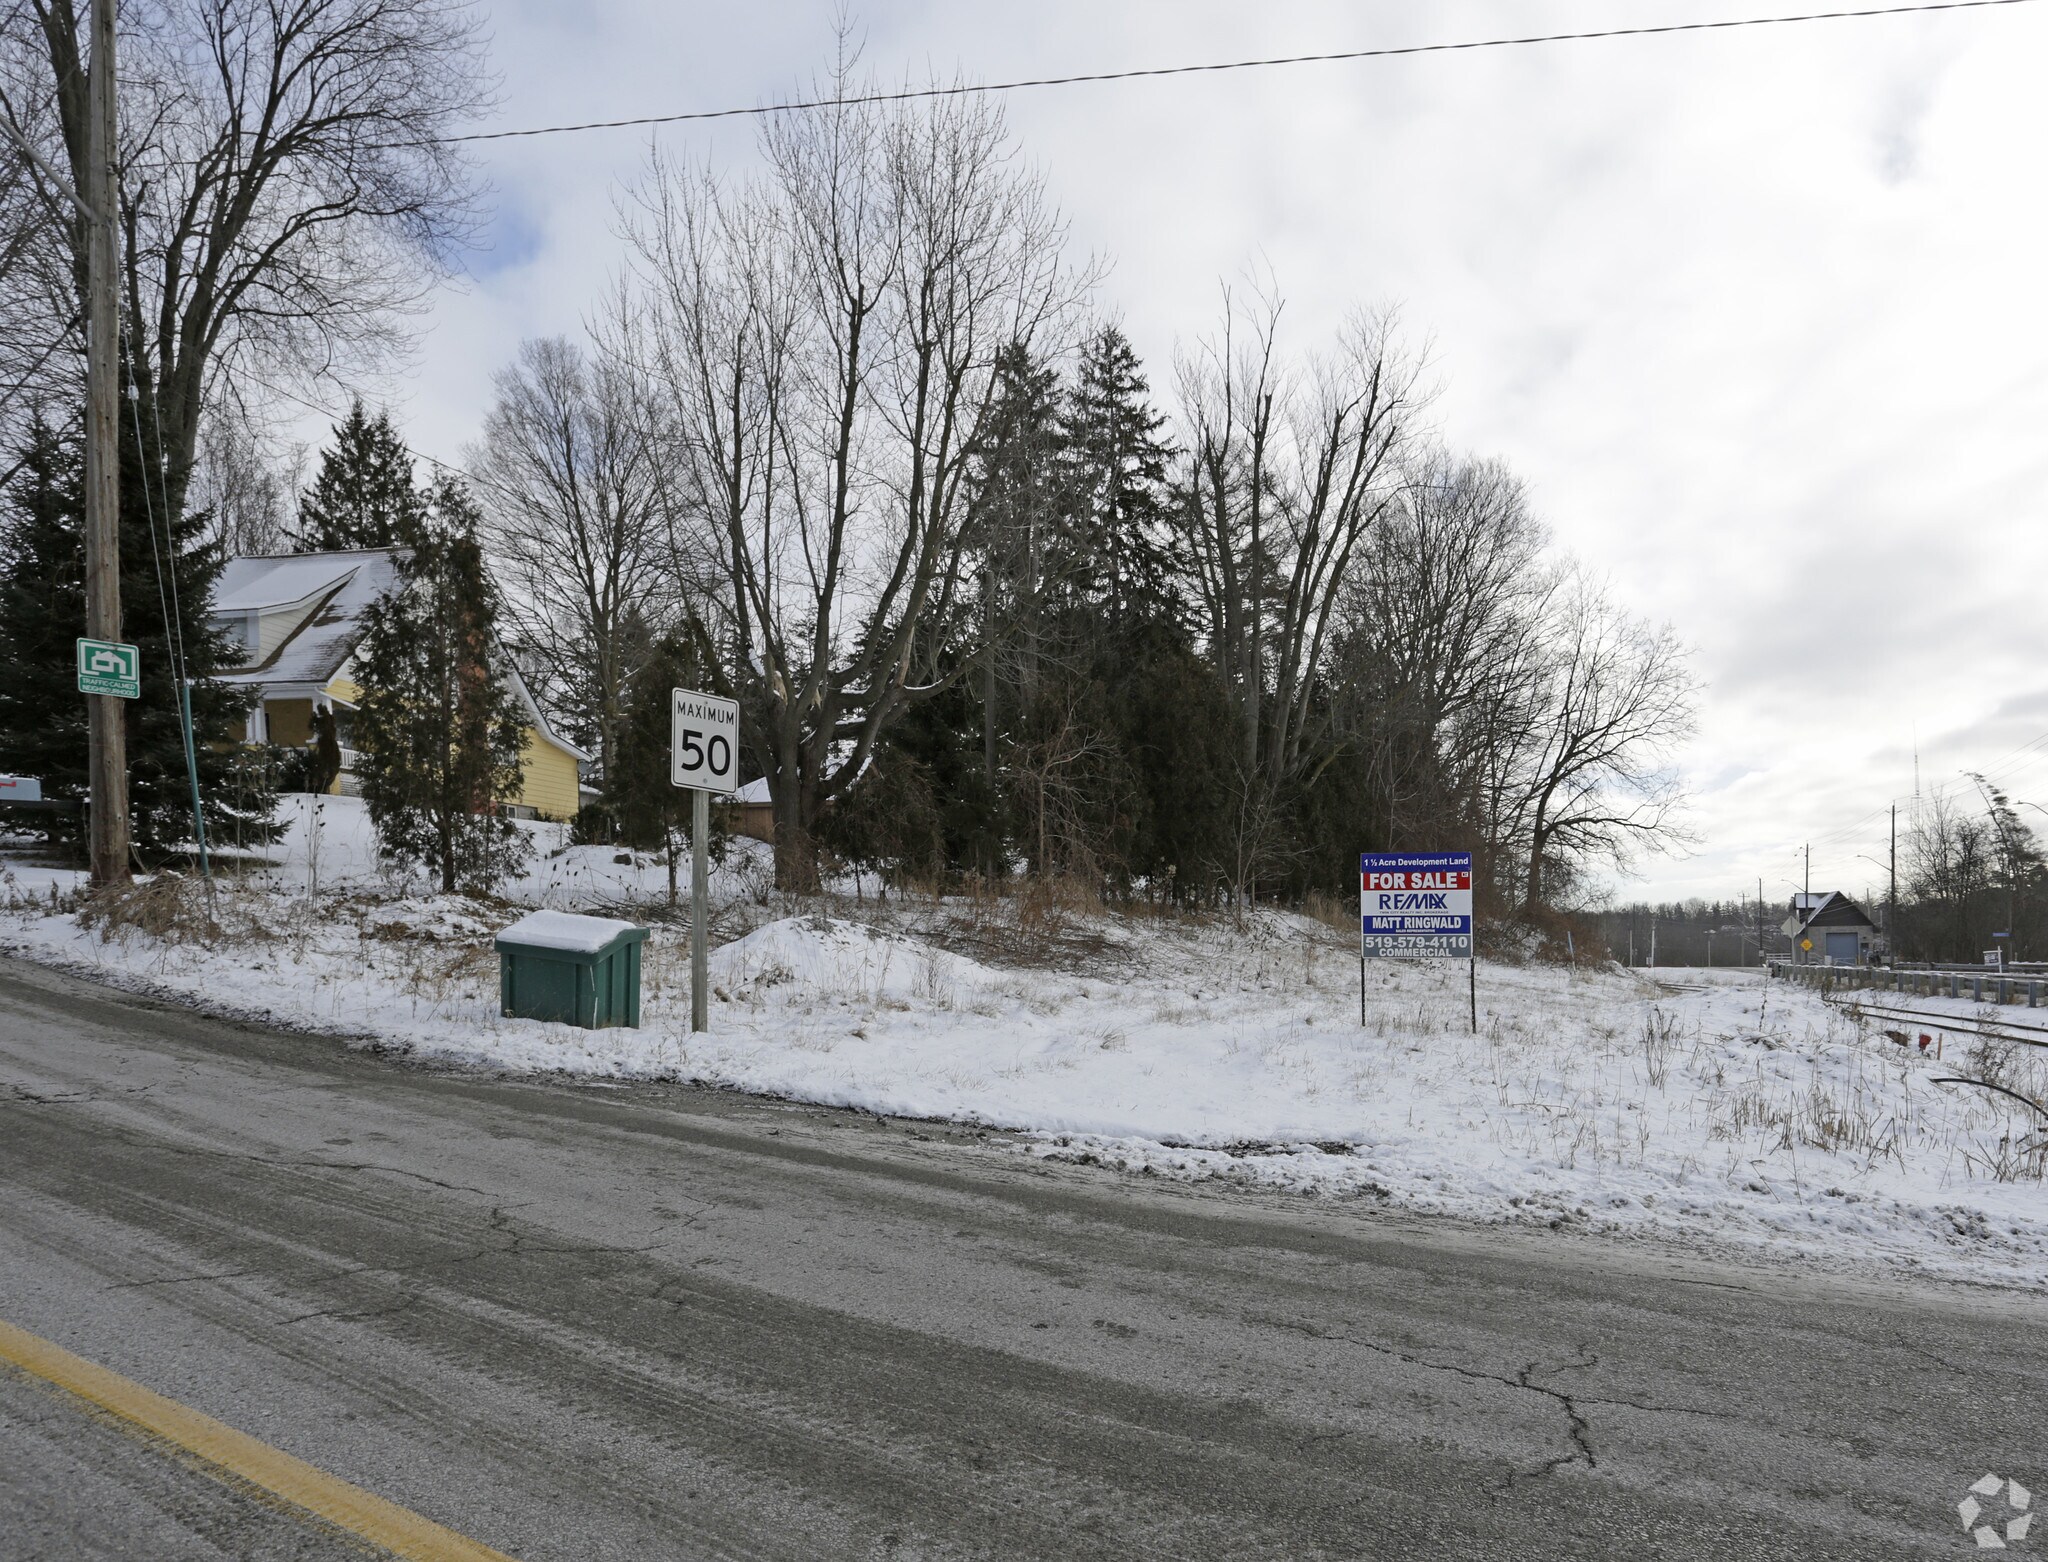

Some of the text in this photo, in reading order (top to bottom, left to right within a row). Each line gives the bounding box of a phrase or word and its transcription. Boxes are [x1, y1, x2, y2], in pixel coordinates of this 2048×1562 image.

[677, 700, 734, 726] MAXIMUM
[681, 729, 731, 776] 50
[1378, 859, 1397, 867] Acre
[1398, 858, 1447, 867] Development
[1449, 857, 1469, 865] Land
[1370, 872, 1458, 889] FOR SALE
[1379, 893, 1448, 910] RE/MAX
[1372, 916, 1462, 929] MATT RINGWALD
[1365, 936, 1468, 948] 519-579-4110
[1379, 948, 1452, 957] COMMERCIAL
